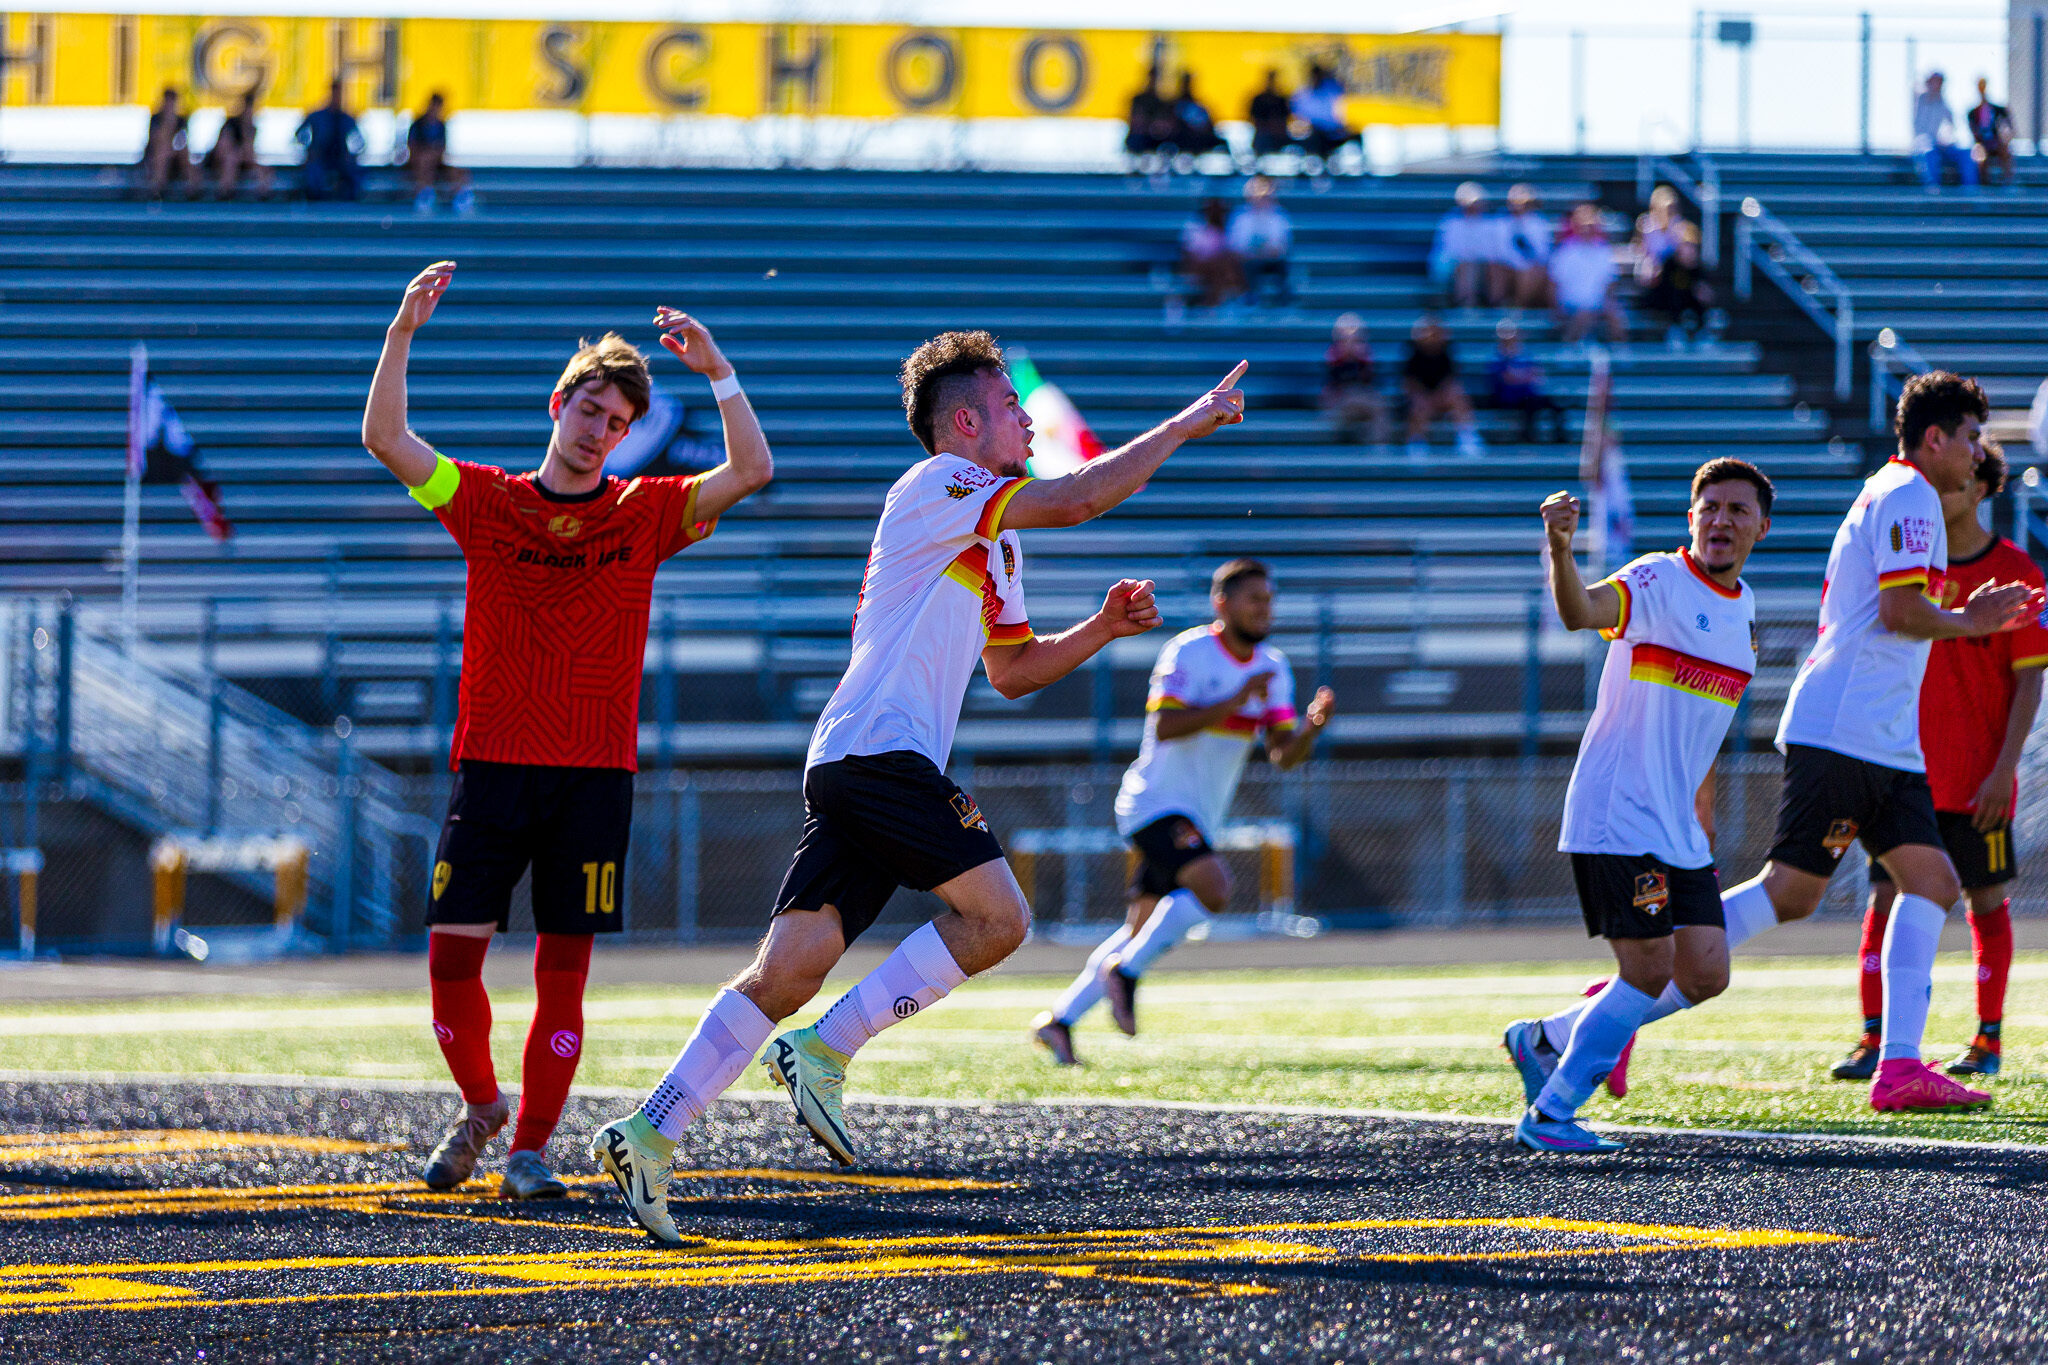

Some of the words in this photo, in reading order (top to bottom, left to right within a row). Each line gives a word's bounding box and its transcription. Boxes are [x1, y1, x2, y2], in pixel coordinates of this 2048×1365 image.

[0, 20, 400, 104] HIGH
[1984, 830, 2006, 872] 11
[582, 861, 616, 914] 10
